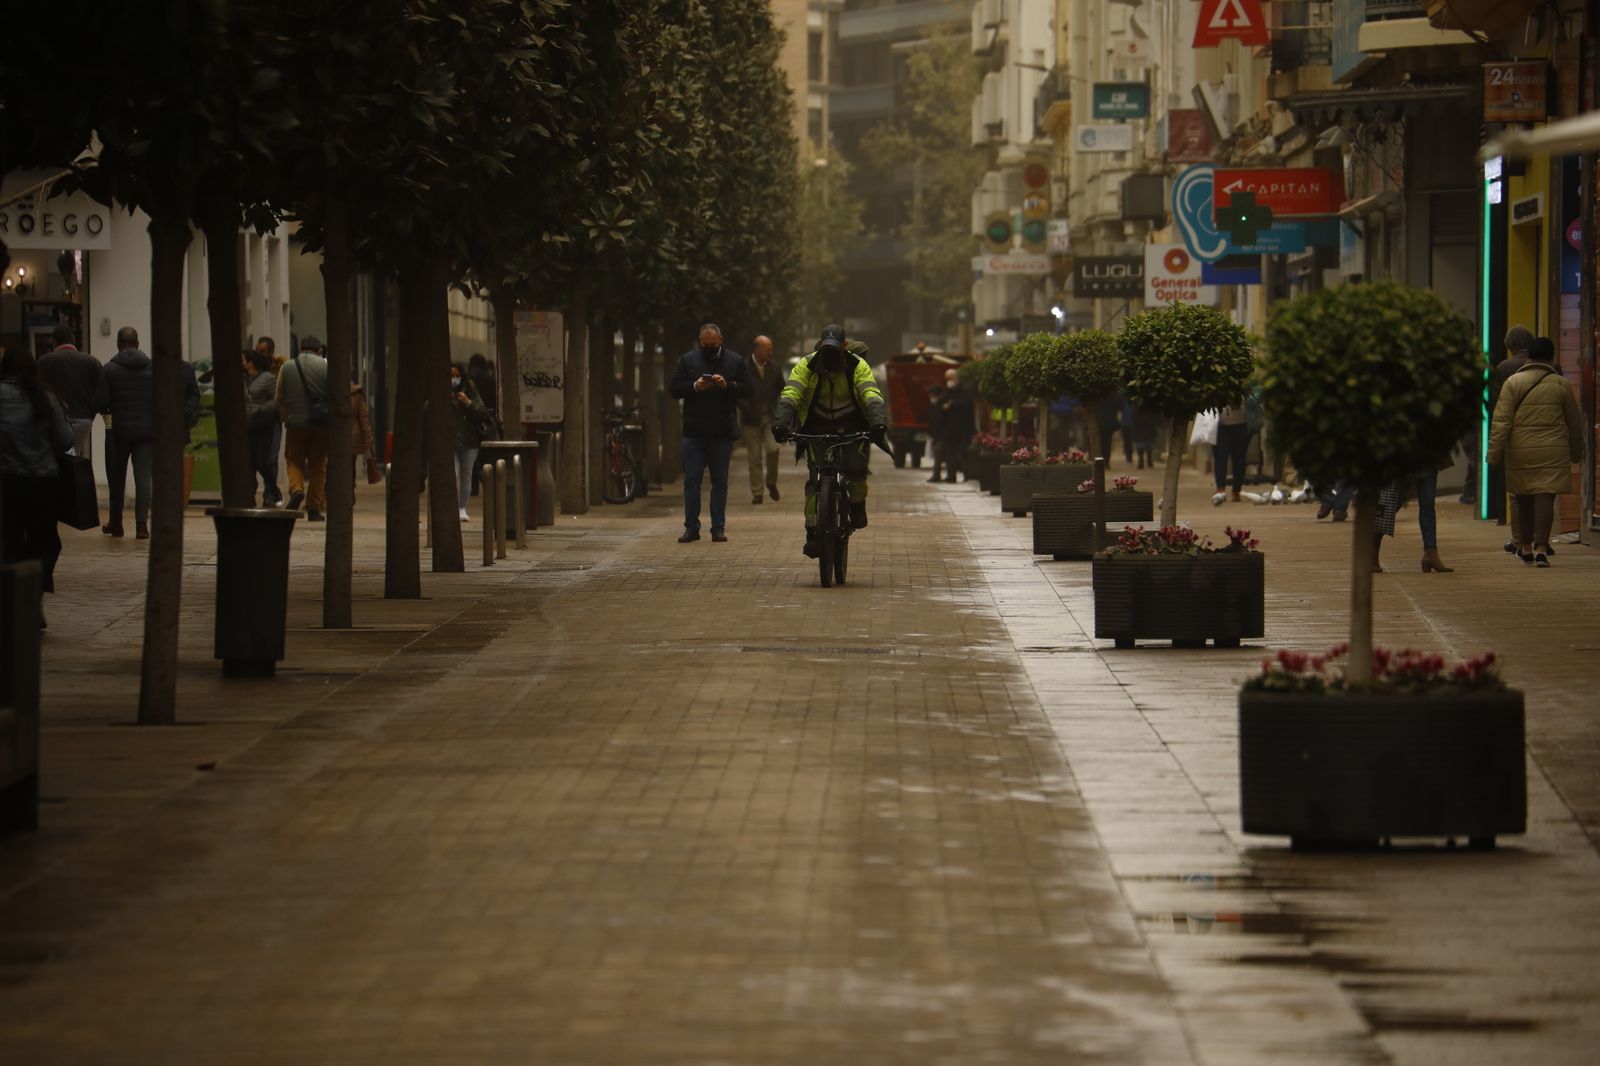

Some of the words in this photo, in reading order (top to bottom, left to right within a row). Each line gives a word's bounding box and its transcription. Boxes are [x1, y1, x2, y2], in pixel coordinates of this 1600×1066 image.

[1490, 68, 1514, 86] 24
[1246, 183, 1320, 195] CAPITAN
[1081, 263, 1143, 278] LUQU
[1151, 277, 1202, 289] General
[1155, 289, 1198, 301] Optica
